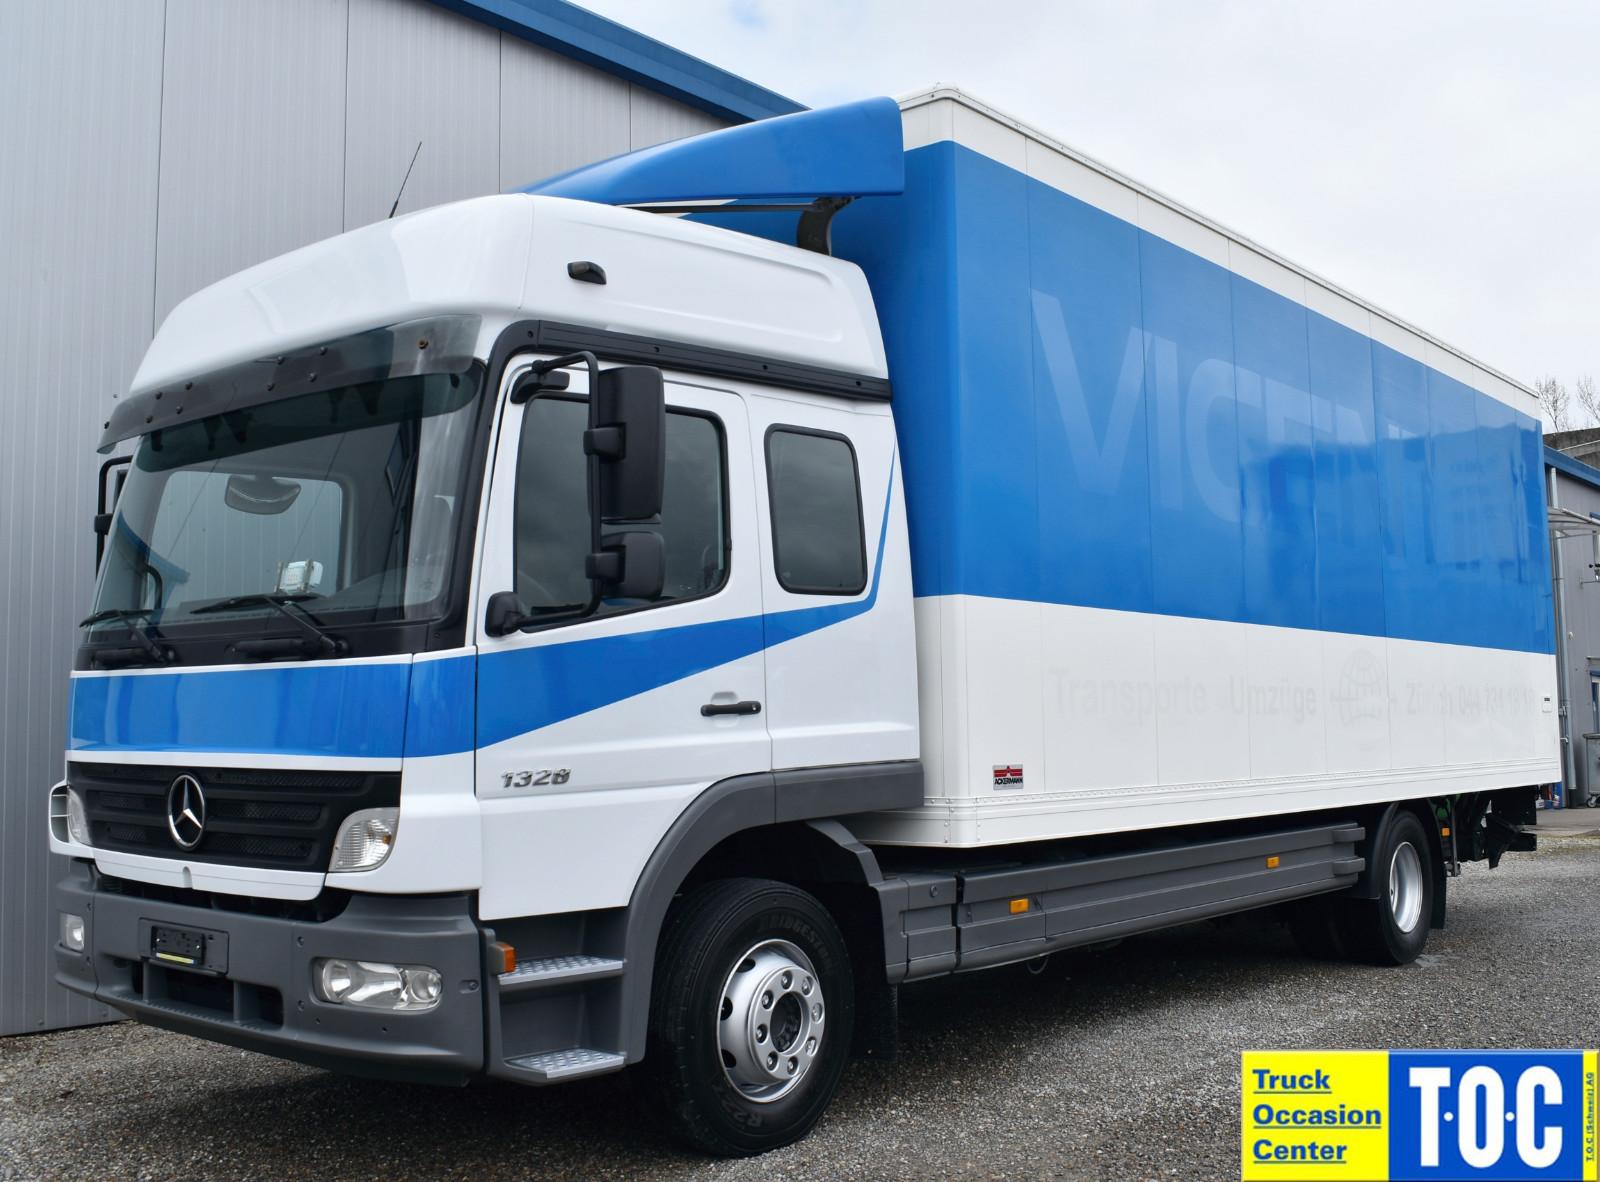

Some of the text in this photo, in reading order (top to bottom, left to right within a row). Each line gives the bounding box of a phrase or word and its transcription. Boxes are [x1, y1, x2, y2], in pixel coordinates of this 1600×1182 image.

[1048, 666, 1208, 728] Transporte
[1229, 673, 1317, 726] Umzüge
[501, 768, 571, 788] 1328
[994, 777, 1024, 785] ACKERMANN
